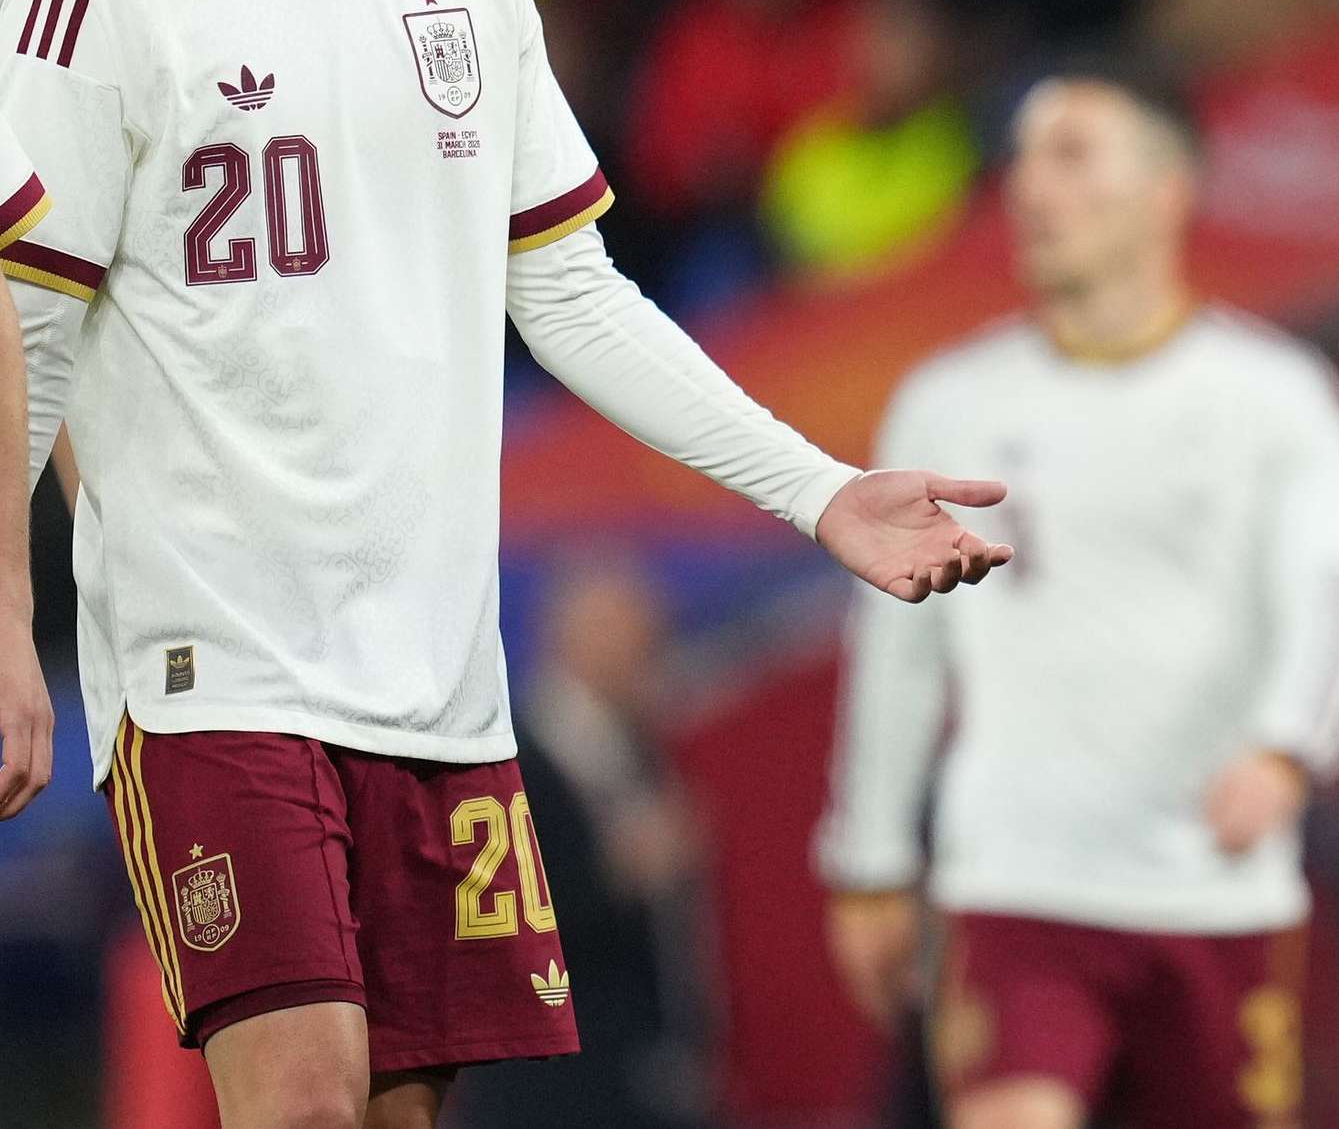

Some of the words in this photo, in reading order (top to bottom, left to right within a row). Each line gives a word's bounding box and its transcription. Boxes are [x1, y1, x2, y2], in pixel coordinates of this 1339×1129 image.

[437, 141, 443, 150] 31
[438, 132, 456, 140] SPAIN
[182, 135, 330, 286] 20
[450, 792, 557, 940] 20
